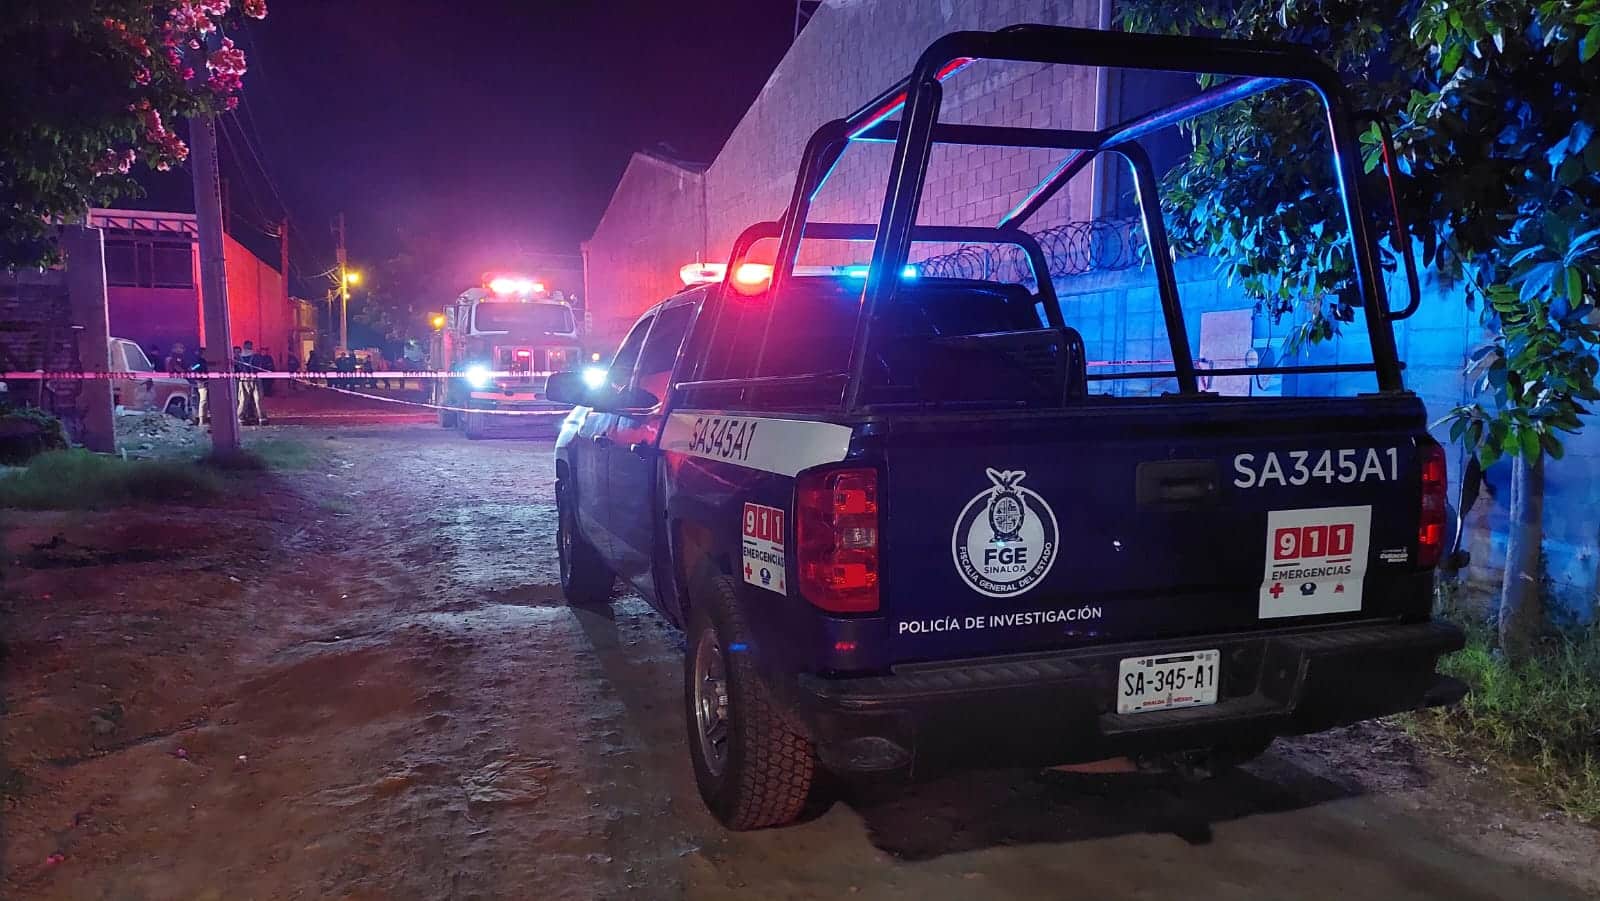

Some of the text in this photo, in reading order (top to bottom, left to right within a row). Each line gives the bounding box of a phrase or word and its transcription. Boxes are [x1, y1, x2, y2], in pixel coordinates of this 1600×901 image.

[689, 418, 757, 461] SA345A1
[1234, 447, 1398, 489] SA345A1
[746, 510, 780, 540] 911
[984, 547, 1027, 566] FGE
[1280, 528, 1347, 556] 911
[979, 580, 1018, 592] GENERAL
[1019, 575, 1035, 588] DEL
[1033, 542, 1052, 576] ESTADO
[984, 565, 1027, 574] SINALOA
[1271, 565, 1351, 581] EMERGENCIAS
[899, 605, 1102, 634] POLICÍA DE INVESTIGACIÓN
[1124, 665, 1213, 696] SA-345-A1
